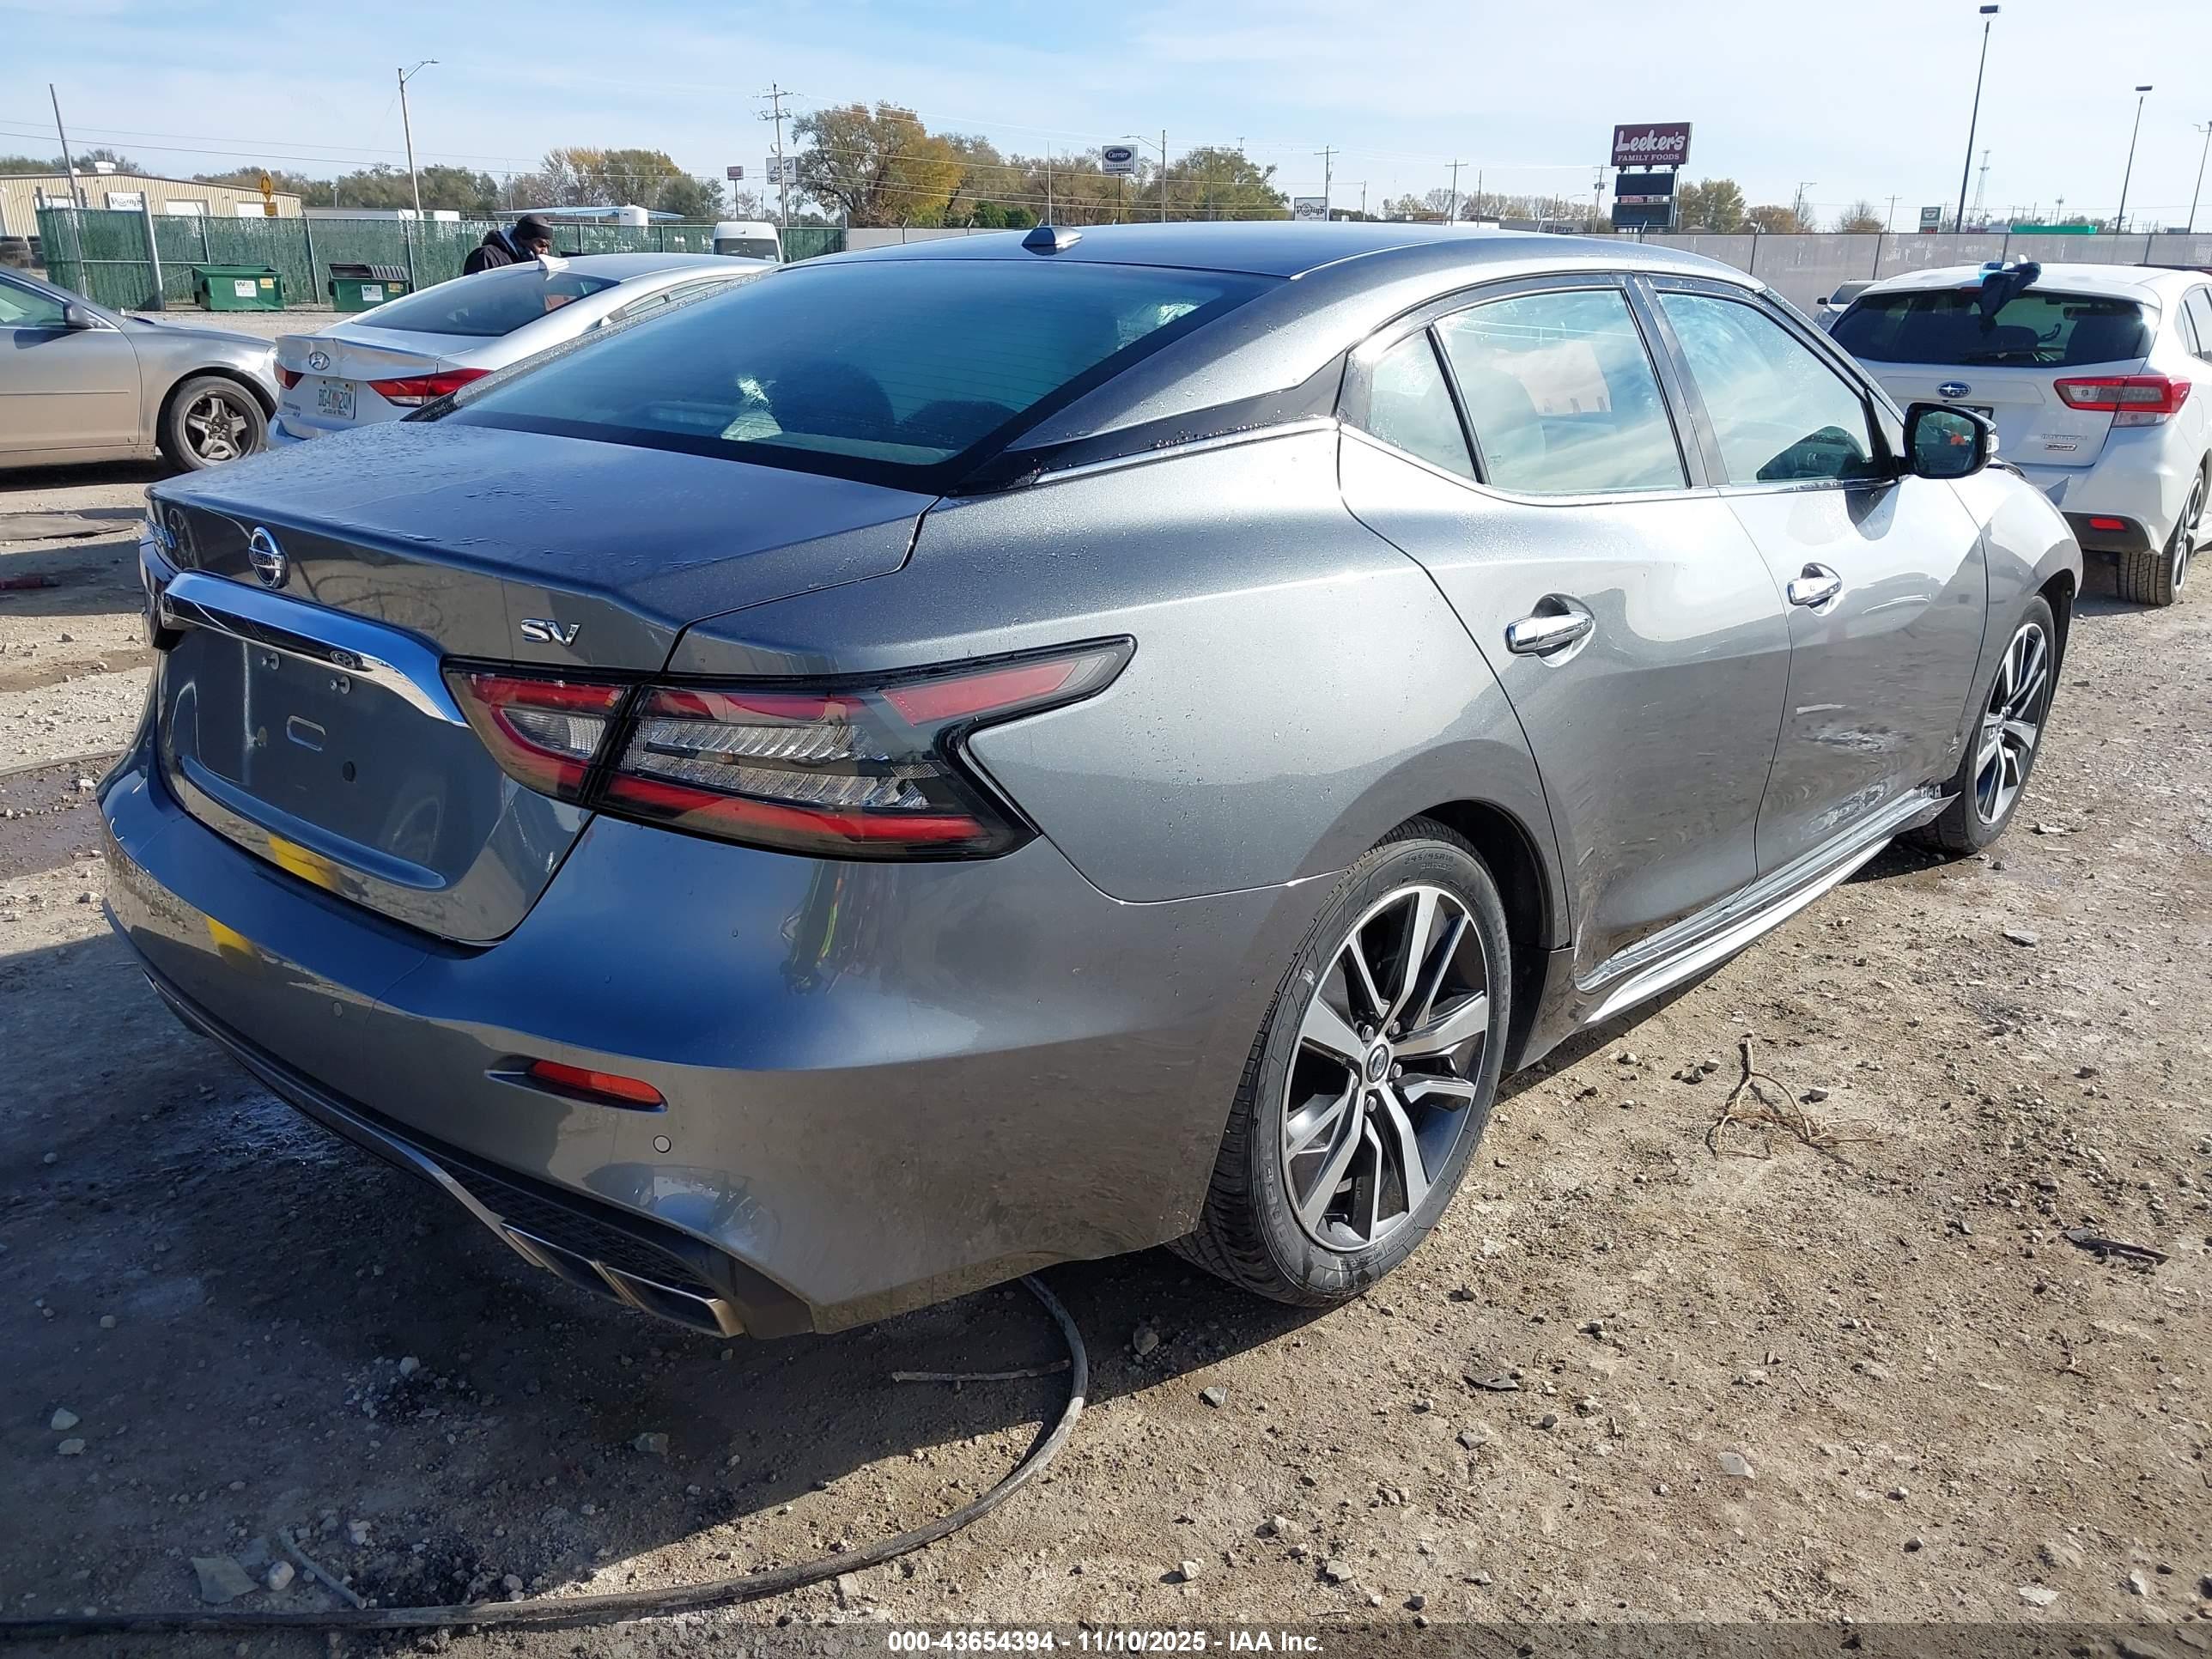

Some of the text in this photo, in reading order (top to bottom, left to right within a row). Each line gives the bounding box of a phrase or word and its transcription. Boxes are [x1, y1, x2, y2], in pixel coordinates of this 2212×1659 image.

[1615, 129, 1686, 152] Leeker's
[1108, 150, 1128, 159] Carrier
[520, 618, 581, 646] SV
